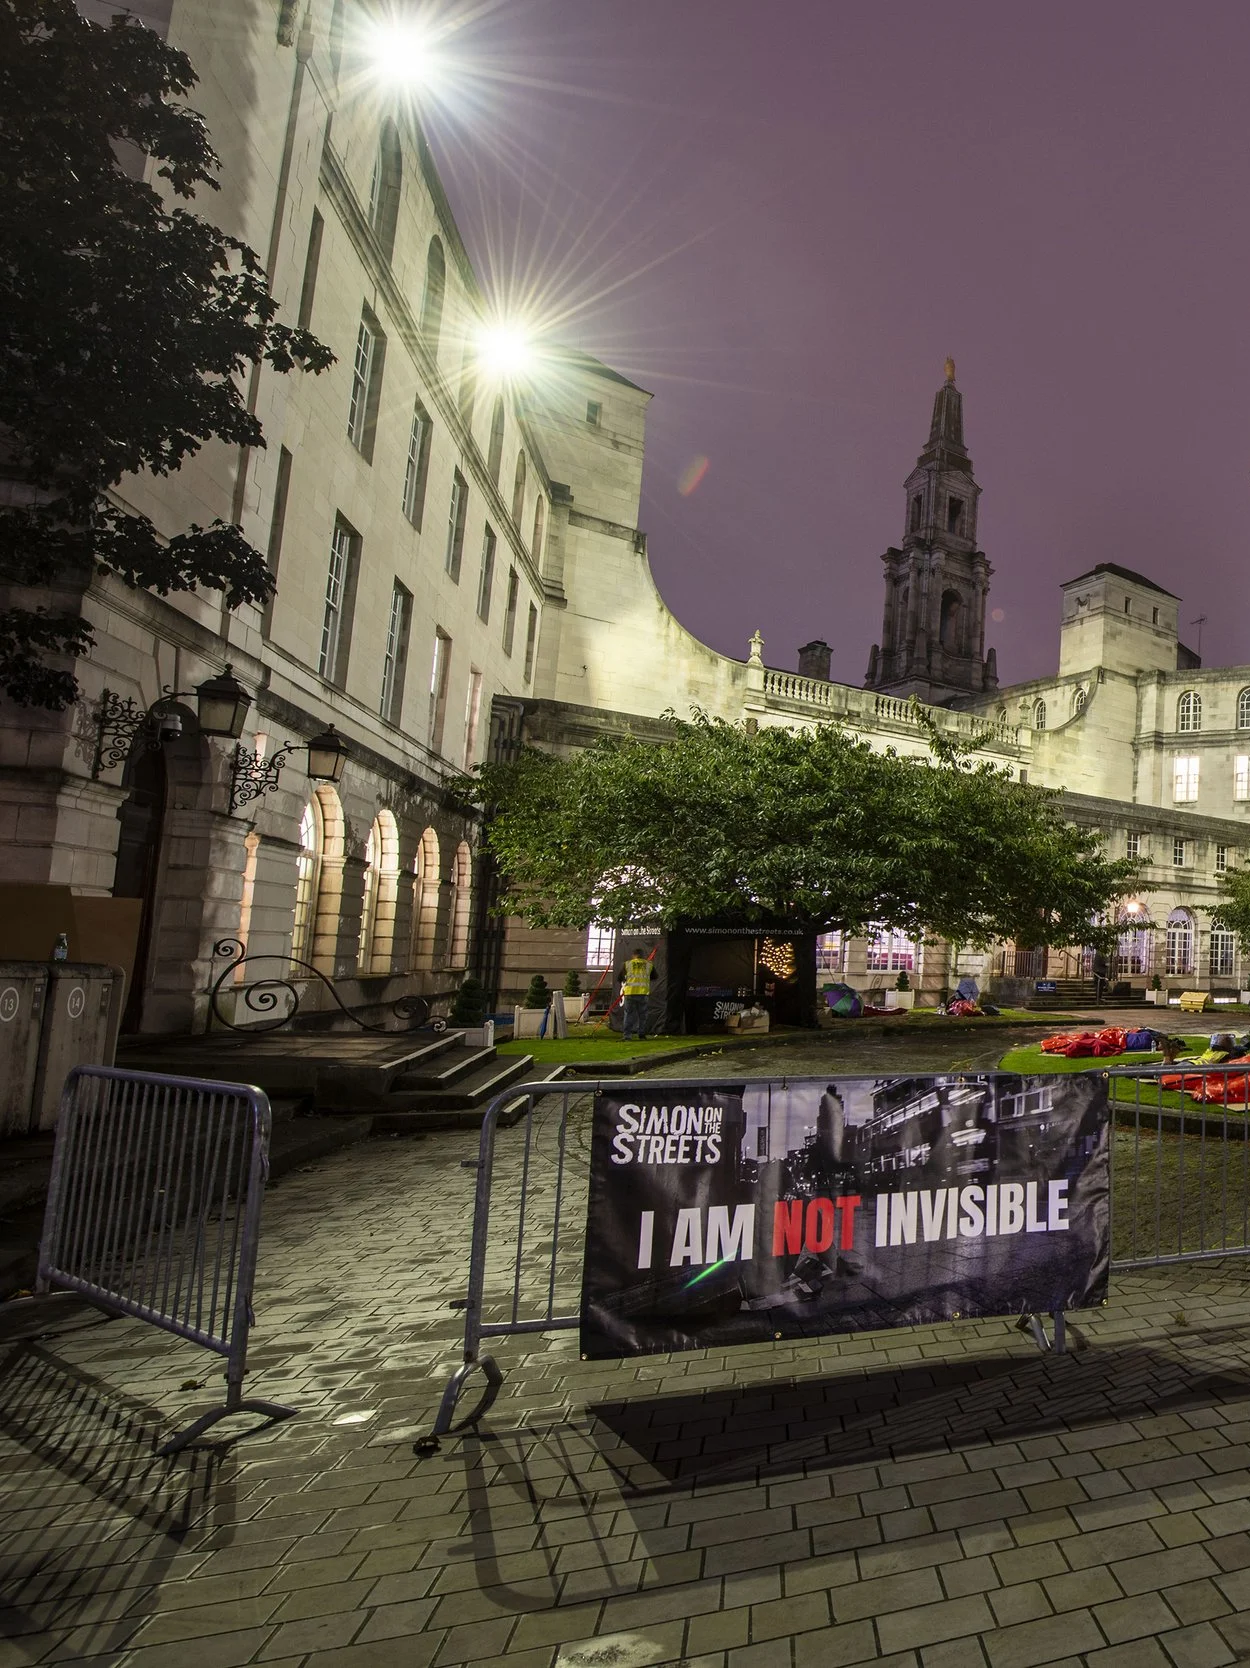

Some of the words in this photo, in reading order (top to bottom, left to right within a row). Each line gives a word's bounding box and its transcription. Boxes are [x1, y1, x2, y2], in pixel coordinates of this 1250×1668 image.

[685, 926, 804, 937] www.simononthestreets.co.uk
[4, 998, 14, 1011] 13
[71, 997, 80, 1009] 14
[616, 1103, 704, 1136] SIMON
[704, 1106, 722, 1123] ON
[704, 1122, 721, 1134] THE
[610, 1132, 722, 1165] STREETS
[637, 1211, 654, 1269] I
[669, 1203, 756, 1267] AM
[772, 1195, 861, 1257] NOT
[875, 1179, 1070, 1247] INVISIBLE
